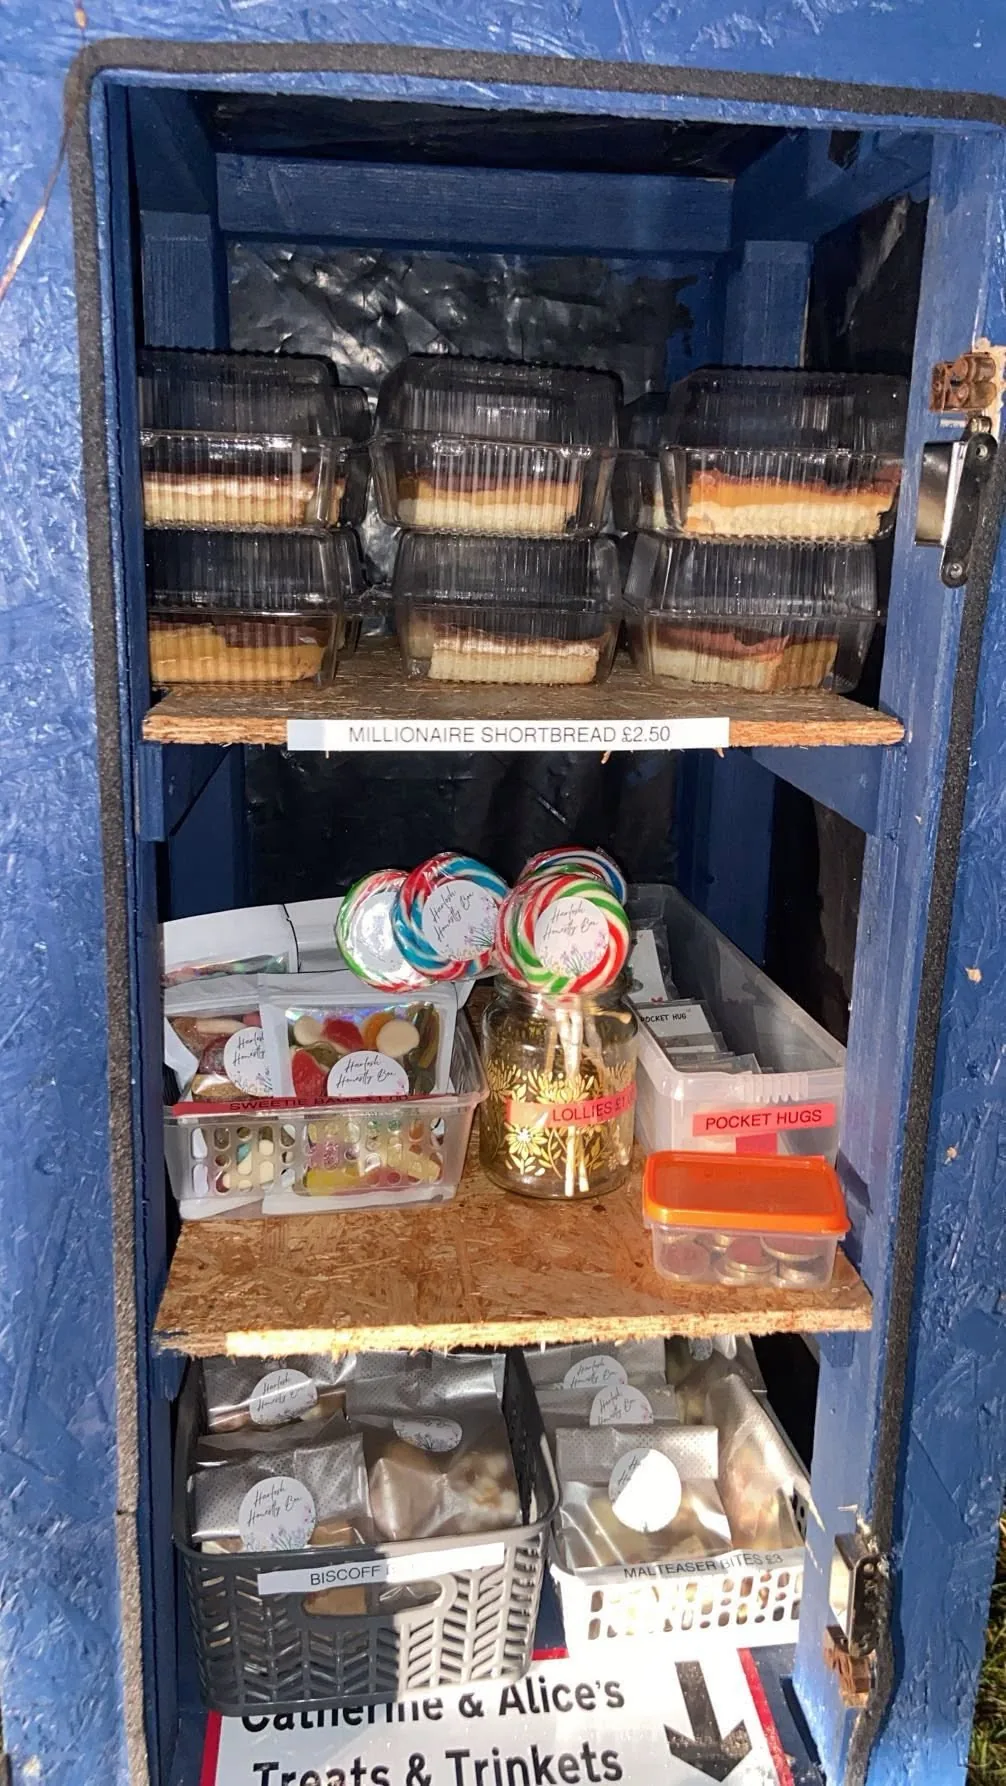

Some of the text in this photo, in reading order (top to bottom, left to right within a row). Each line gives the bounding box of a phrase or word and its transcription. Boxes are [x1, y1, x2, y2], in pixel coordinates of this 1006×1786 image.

[348, 725, 671, 743] MILLIONAIRE SHORTBREAD £2.50
[640, 1012, 687, 1023] POCKET HUG
[552, 1101, 613, 1121] LOLLIES
[705, 1109, 822, 1131] POCKET HUGS
[310, 1565, 382, 1586] BISCOFF
[623, 1553, 783, 1579] MALTEASER BITES £3
[458, 1691, 485, 1718] &
[498, 1675, 625, 1716] Alice's
[253, 1741, 623, 1786] Treats & Trinkets
